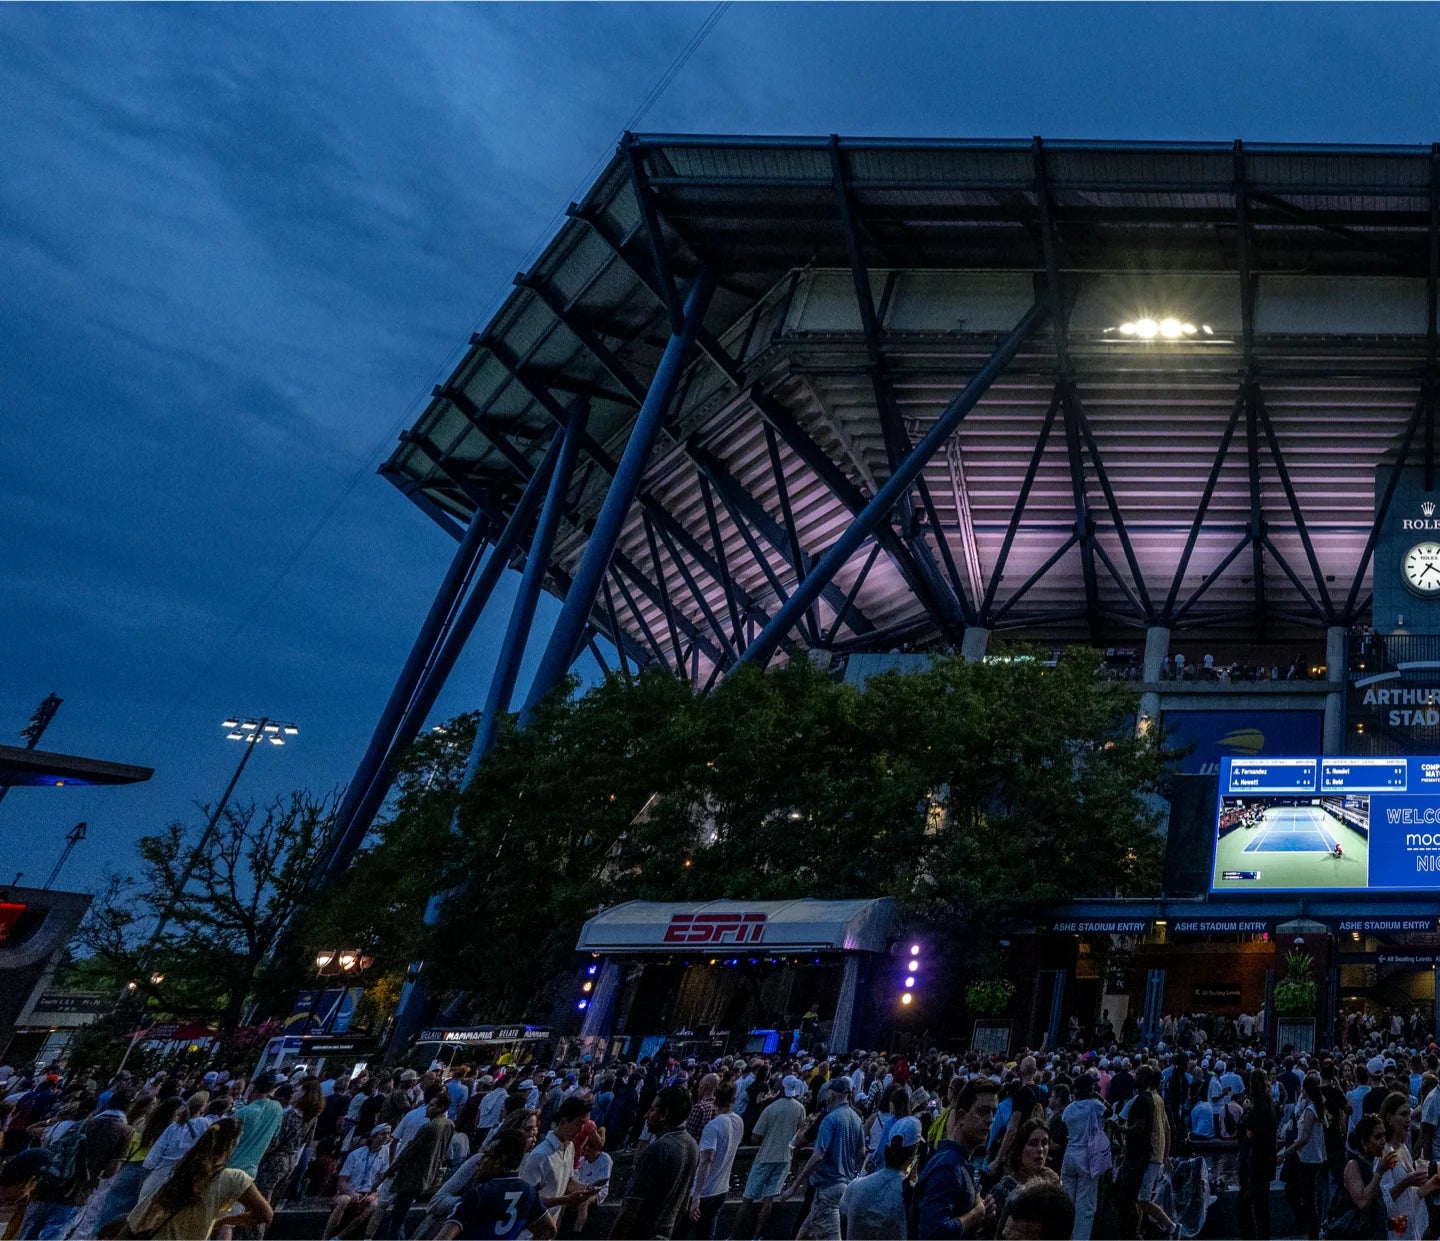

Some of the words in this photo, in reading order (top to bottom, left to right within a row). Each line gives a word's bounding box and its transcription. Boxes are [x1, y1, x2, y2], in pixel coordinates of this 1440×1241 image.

[664, 913, 768, 942] ESPN
[1053, 923, 1076, 931] ASHE
[1078, 923, 1115, 931] STADIUM
[1117, 923, 1146, 931] ENTRY
[1175, 922, 1198, 930] ASHE
[1200, 922, 1237, 930] STADIUM
[1238, 922, 1267, 930] ENTRY
[1339, 921, 1362, 930] ASHE
[1364, 921, 1400, 930] STADIUM
[1402, 921, 1430, 930] ENTRY
[420, 1031, 442, 1040] GELATO
[446, 1031, 493, 1040] MAMMAMIA
[499, 1029, 520, 1038] GELATO
[494, 1192, 523, 1236] 3
